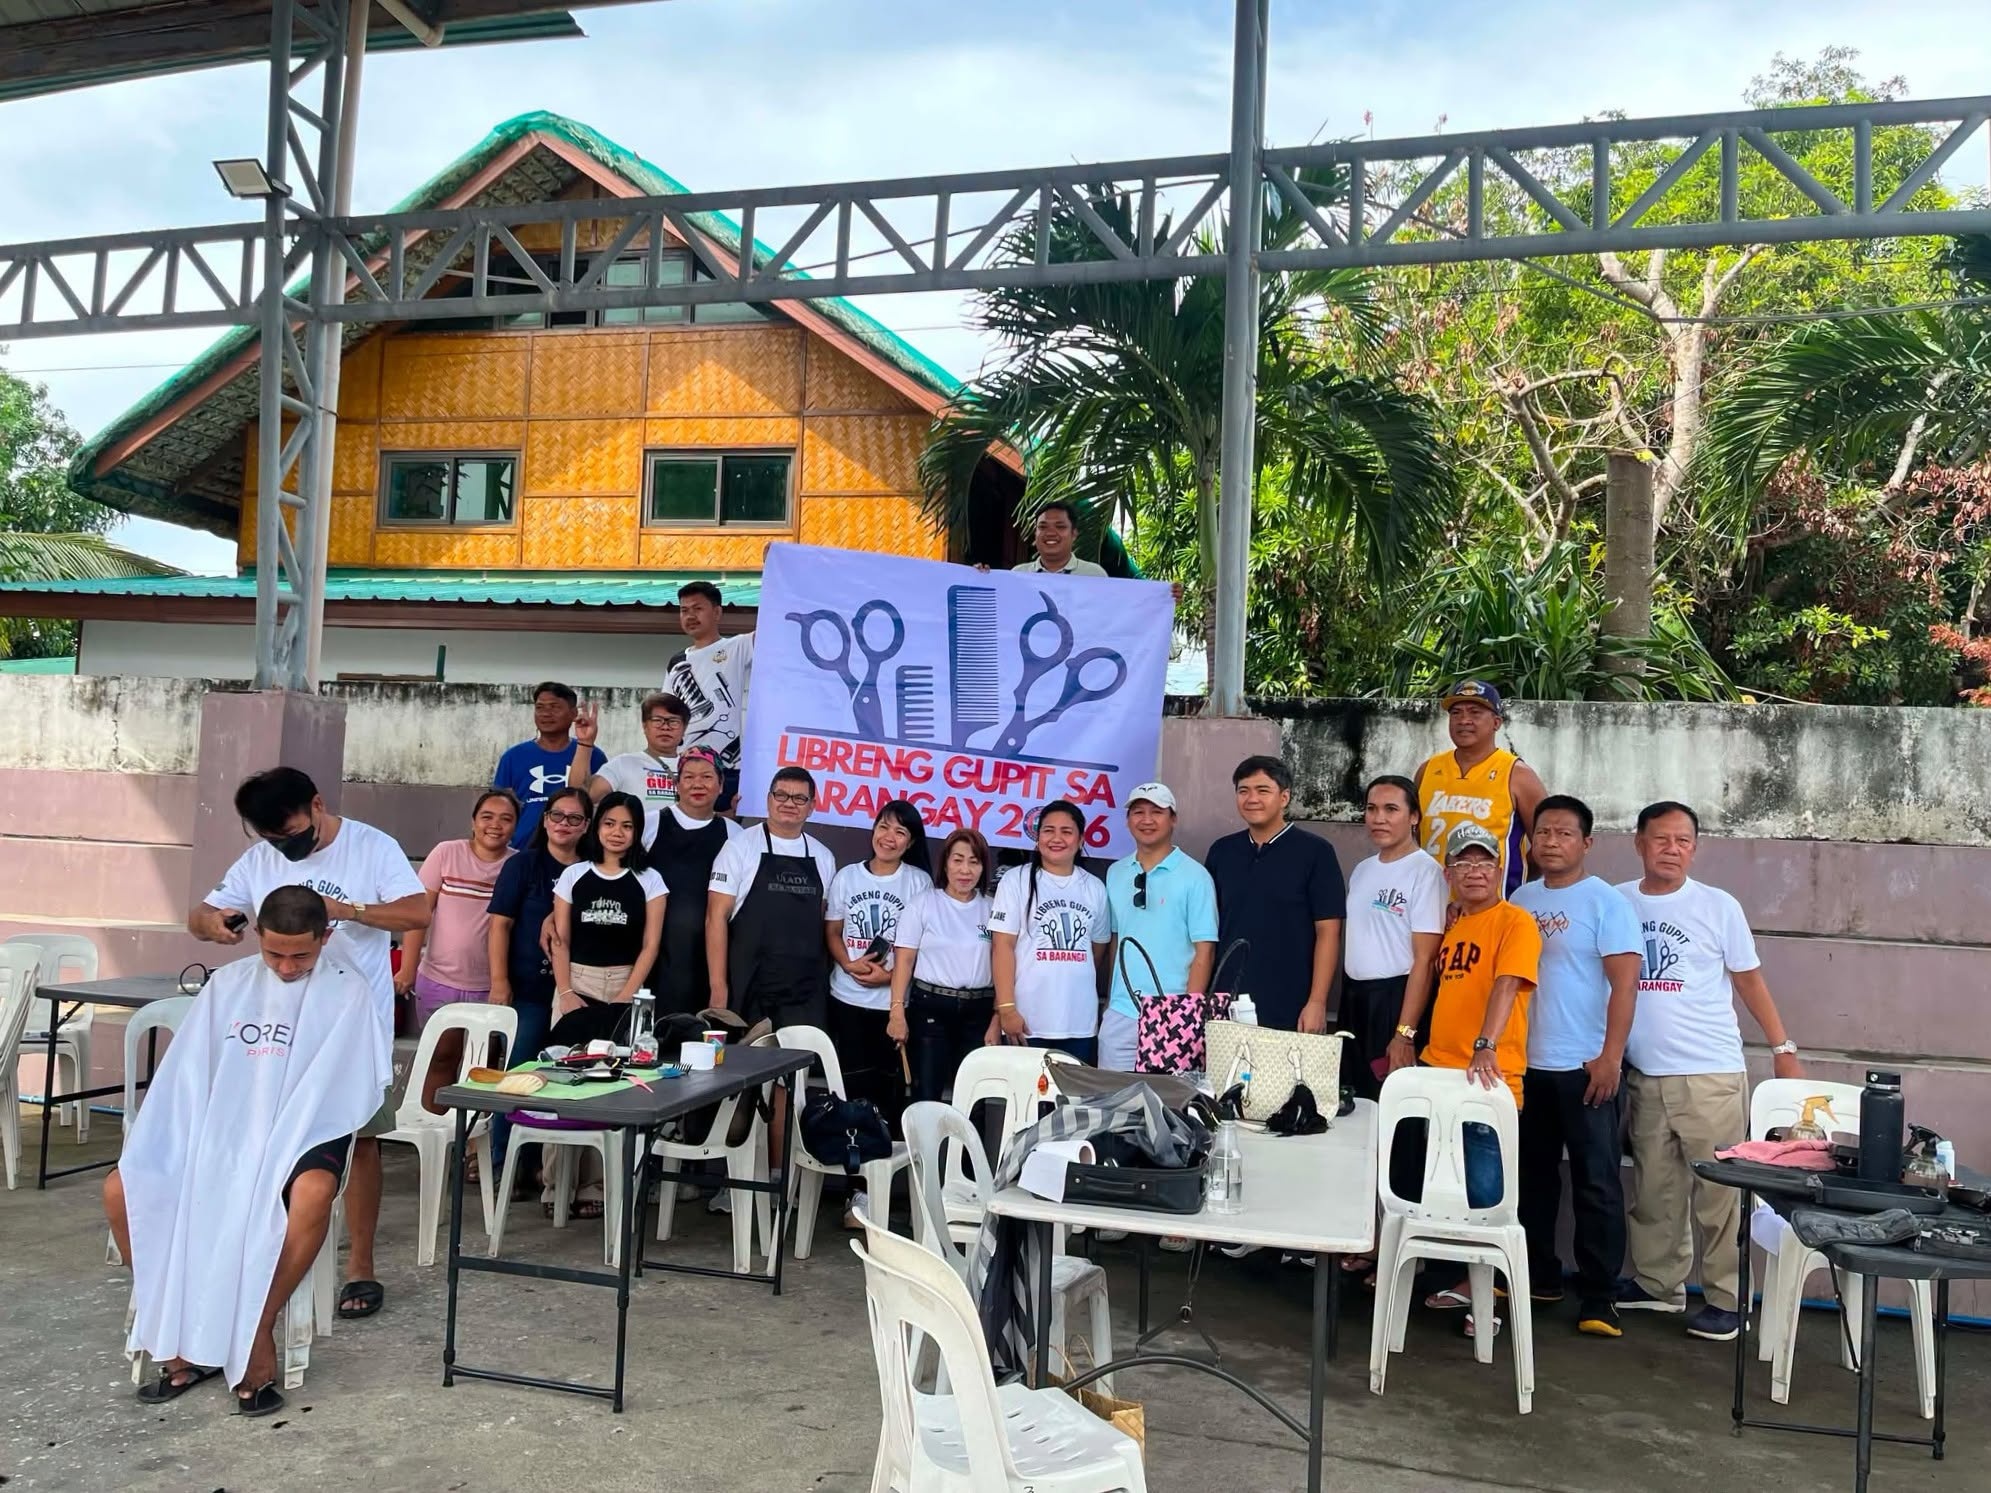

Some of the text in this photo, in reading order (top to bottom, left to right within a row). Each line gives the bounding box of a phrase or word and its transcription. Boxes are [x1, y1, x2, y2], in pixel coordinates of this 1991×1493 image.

[777, 735, 1117, 808] LIBRENG GUPIT SA
[814, 779, 995, 832] RANGAY
[995, 803, 1111, 848] 26
[1427, 818, 1447, 855] 2
[317, 880, 349, 902] GUPIT
[847, 890, 881, 910] LIBRENG
[591, 896, 622, 912] TOKYO
[1034, 899, 1067, 921] LIBRENG
[1659, 922, 1690, 945] GUPIT
[1036, 951, 1047, 961] SA
[1437, 941, 1481, 974] GAP
[1638, 981, 1684, 993] RANGAY
